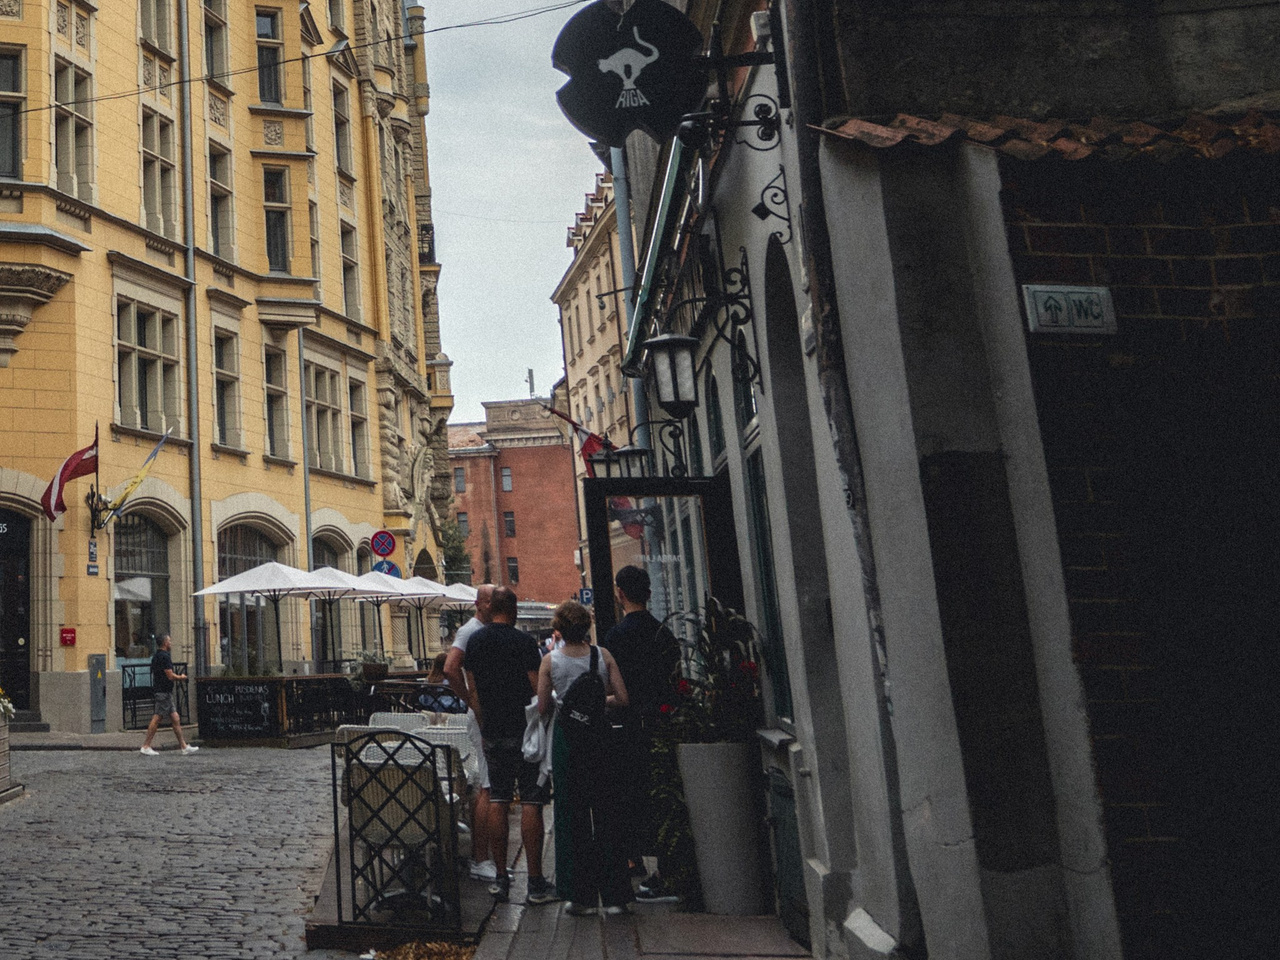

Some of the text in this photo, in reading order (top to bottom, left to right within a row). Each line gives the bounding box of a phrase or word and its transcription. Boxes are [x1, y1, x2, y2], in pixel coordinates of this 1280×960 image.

[615, 89, 651, 109] RIGA
[1072, 297, 1102, 320] WC
[583, 590, 592, 603] P
[206, 694, 235, 704] LUNCH
